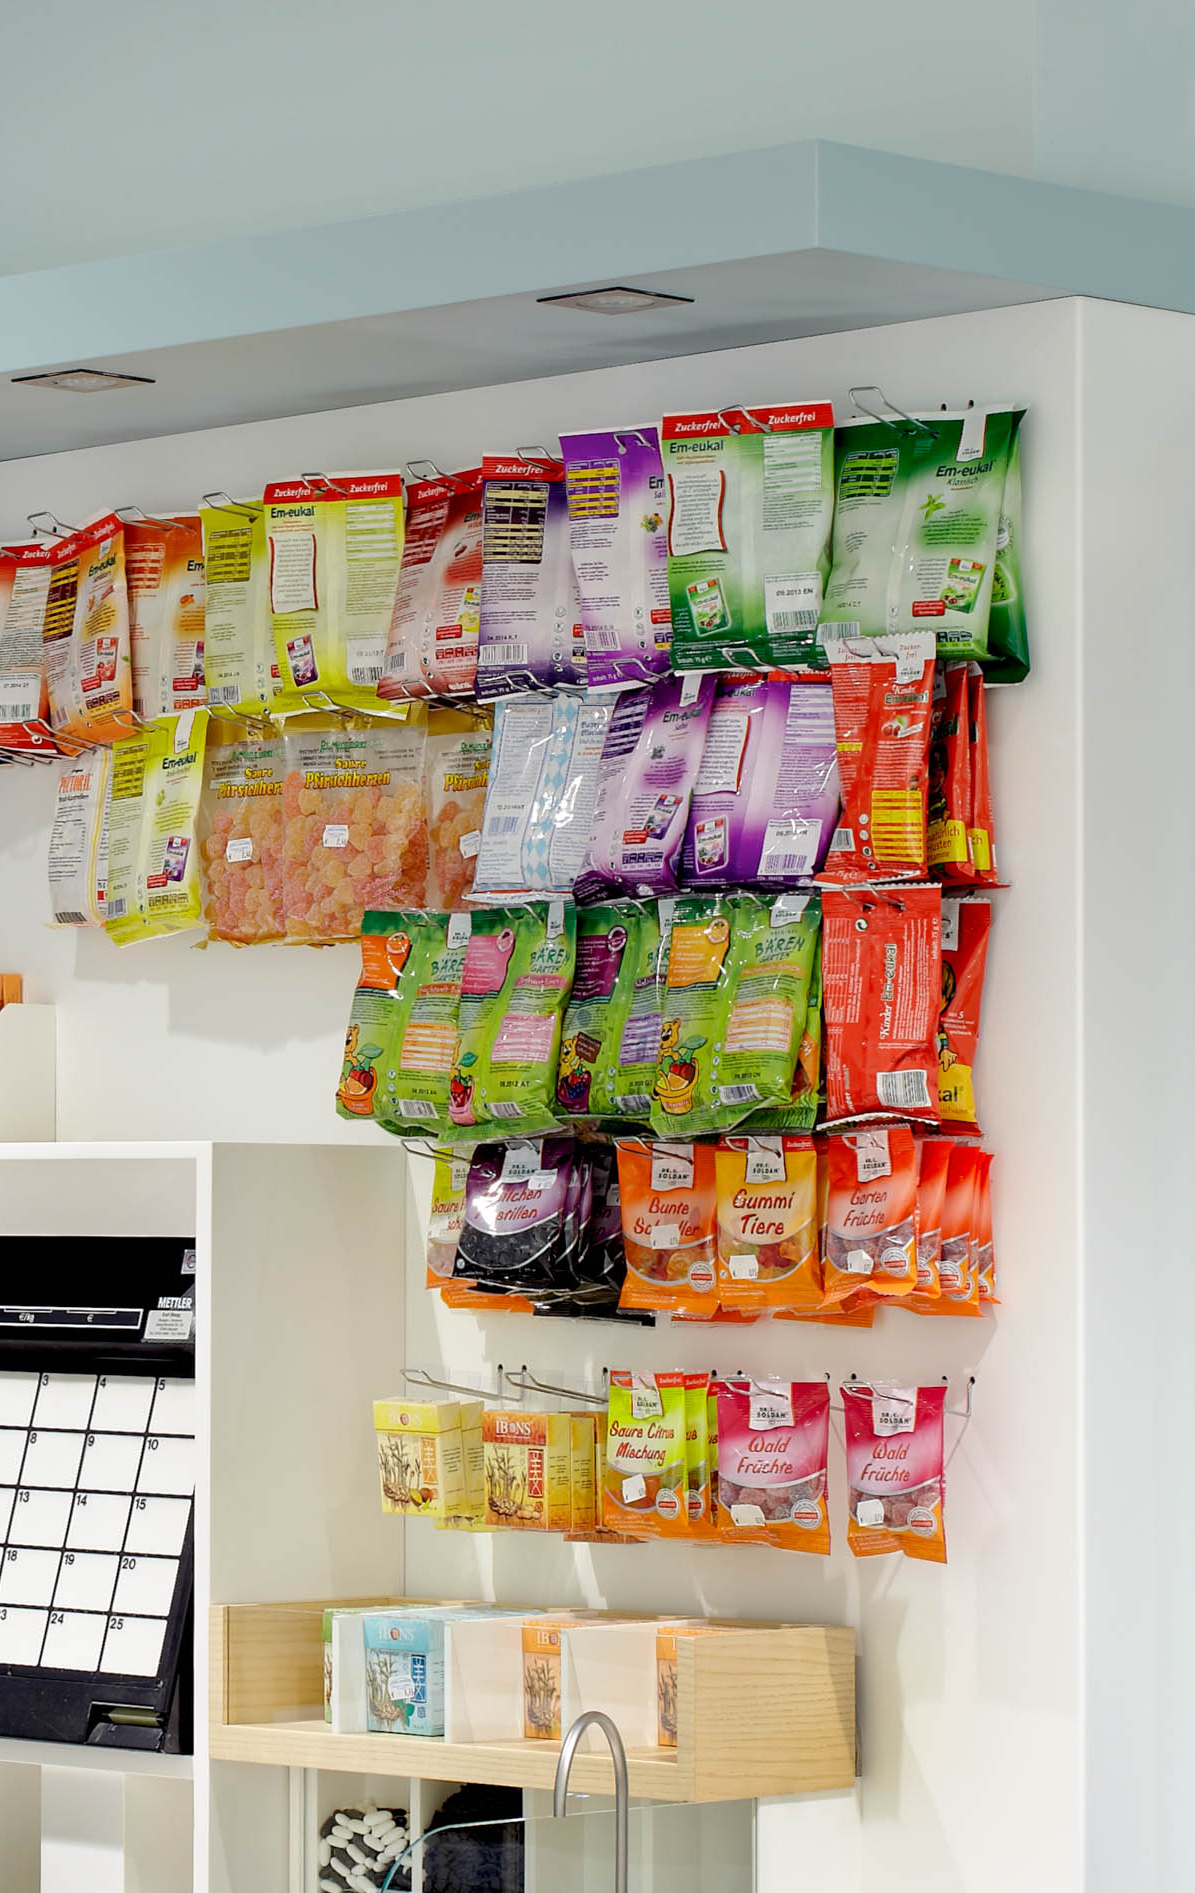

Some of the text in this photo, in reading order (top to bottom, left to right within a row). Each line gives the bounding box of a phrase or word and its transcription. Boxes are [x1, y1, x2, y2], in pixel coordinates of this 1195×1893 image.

[675, 420, 721, 432] Zuckerfrei
[769, 412, 816, 425] Zuckerfrei
[669, 440, 724, 454] Em-eukal
[496, 465, 544, 475] Zuckerfrei
[936, 459, 994, 478] Em-eukal
[350, 482, 388, 493] Zuckerfrei
[947, 477, 980, 487] Klassisch
[274, 487, 311, 497] Zuckerfrei
[270, 505, 315, 518] Em-eukal
[22, 550, 52, 561] Zuckerf
[163, 753, 197, 770] Em-eukal
[334, 758, 367, 769] Saure
[245, 767, 274, 779] Saure
[305, 771, 390, 789] Pfirsichherzen
[217, 778, 283, 800] Pfirsichherz
[755, 936, 806, 957] BÄREN
[530, 949, 570, 966] BÄREN
[431, 958, 465, 976] BÄRE
[880, 943, 897, 1040] Kinder Em-eukal
[649, 1197, 690, 1215] Bunte
[733, 1188, 796, 1209] Gummi
[850, 1188, 887, 1206] Garten
[634, 1217, 703, 1236] Scller
[741, 1213, 785, 1235] Tiere
[843, 1209, 885, 1228] Früchte
[158, 1297, 193, 1309] METTLER
[42, 1374, 49, 1386] 3
[100, 1377, 107, 1388] 4
[158, 1379, 166, 1391] 5
[495, 1420, 532, 1436] IBONS
[609, 1420, 675, 1440] Saure Citrus
[879, 1417, 910, 1425] SOLDAN
[30, 1433, 37, 1444] 8
[87, 1435, 94, 1447] 9
[147, 1438, 159, 1451] 10
[748, 1435, 792, 1454] Wald
[872, 1439, 910, 1461] Wald
[616, 1441, 666, 1467] Mischung
[736, 1456, 794, 1475] Früchte
[861, 1463, 911, 1482] Früchte
[19, 1491, 30, 1503] 13
[76, 1494, 87, 1506] 14
[135, 1498, 147, 1510] 15
[7, 1550, 18, 1562] 18
[64, 1553, 75, 1566] 19
[122, 1558, 136, 1570] 20
[50, 1613, 64, 1625] 24
[109, 1618, 124, 1630] 25
